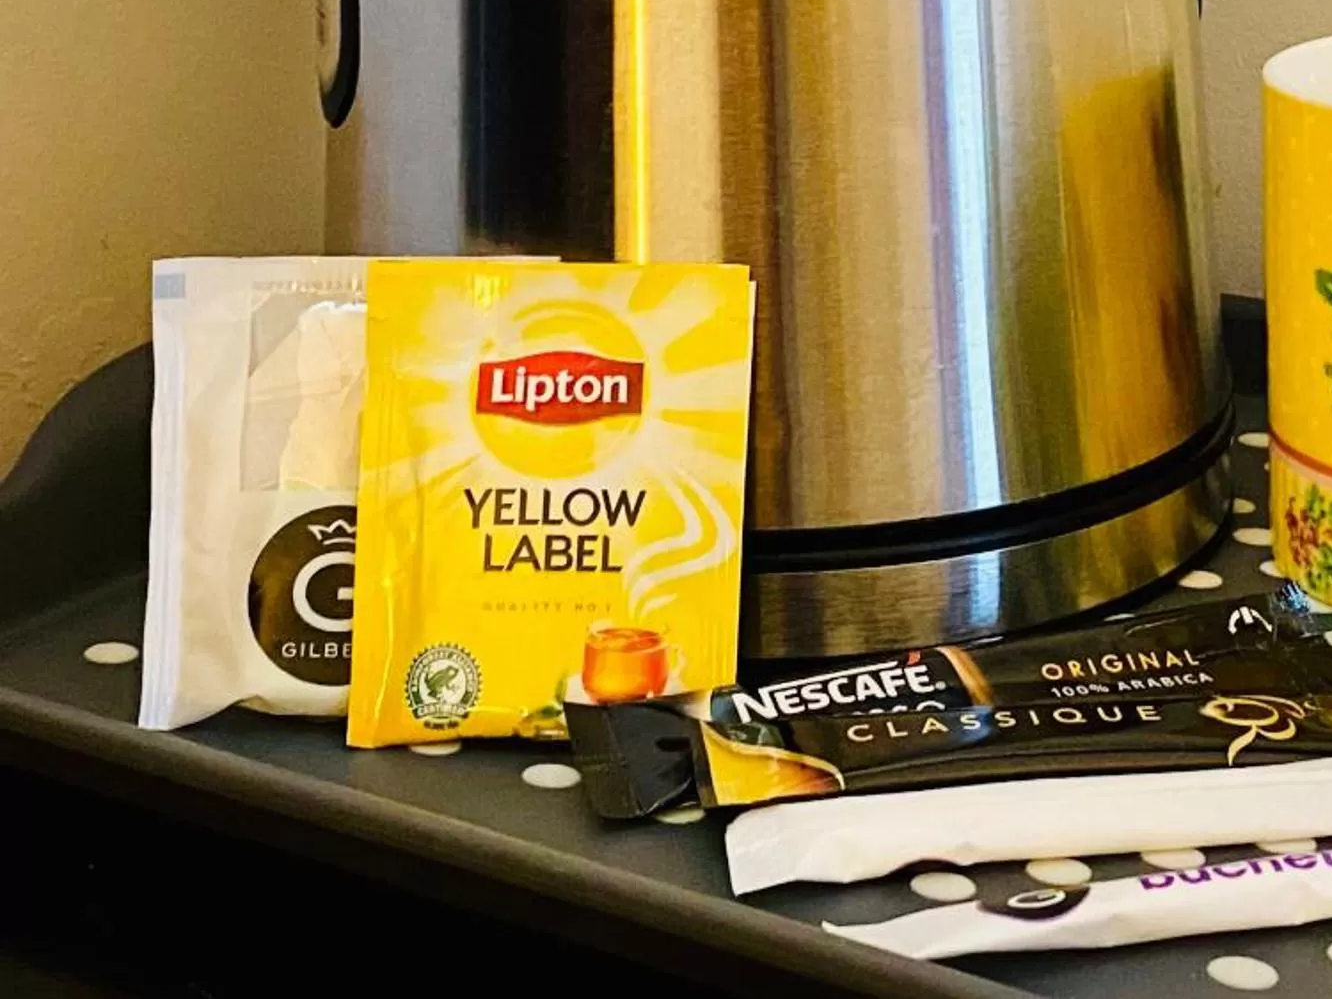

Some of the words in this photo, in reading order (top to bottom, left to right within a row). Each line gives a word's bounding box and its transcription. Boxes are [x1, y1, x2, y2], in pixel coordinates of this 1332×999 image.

[491, 366, 628, 412] Lipton
[464, 488, 647, 529] YELLOW
[483, 533, 623, 572] LABEL
[1041, 649, 1200, 681] ORIGINAL
[1051, 683, 1110, 699] 100%
[1118, 672, 1214, 693] ARABICA
[847, 705, 1162, 742] CLASSIQUE
